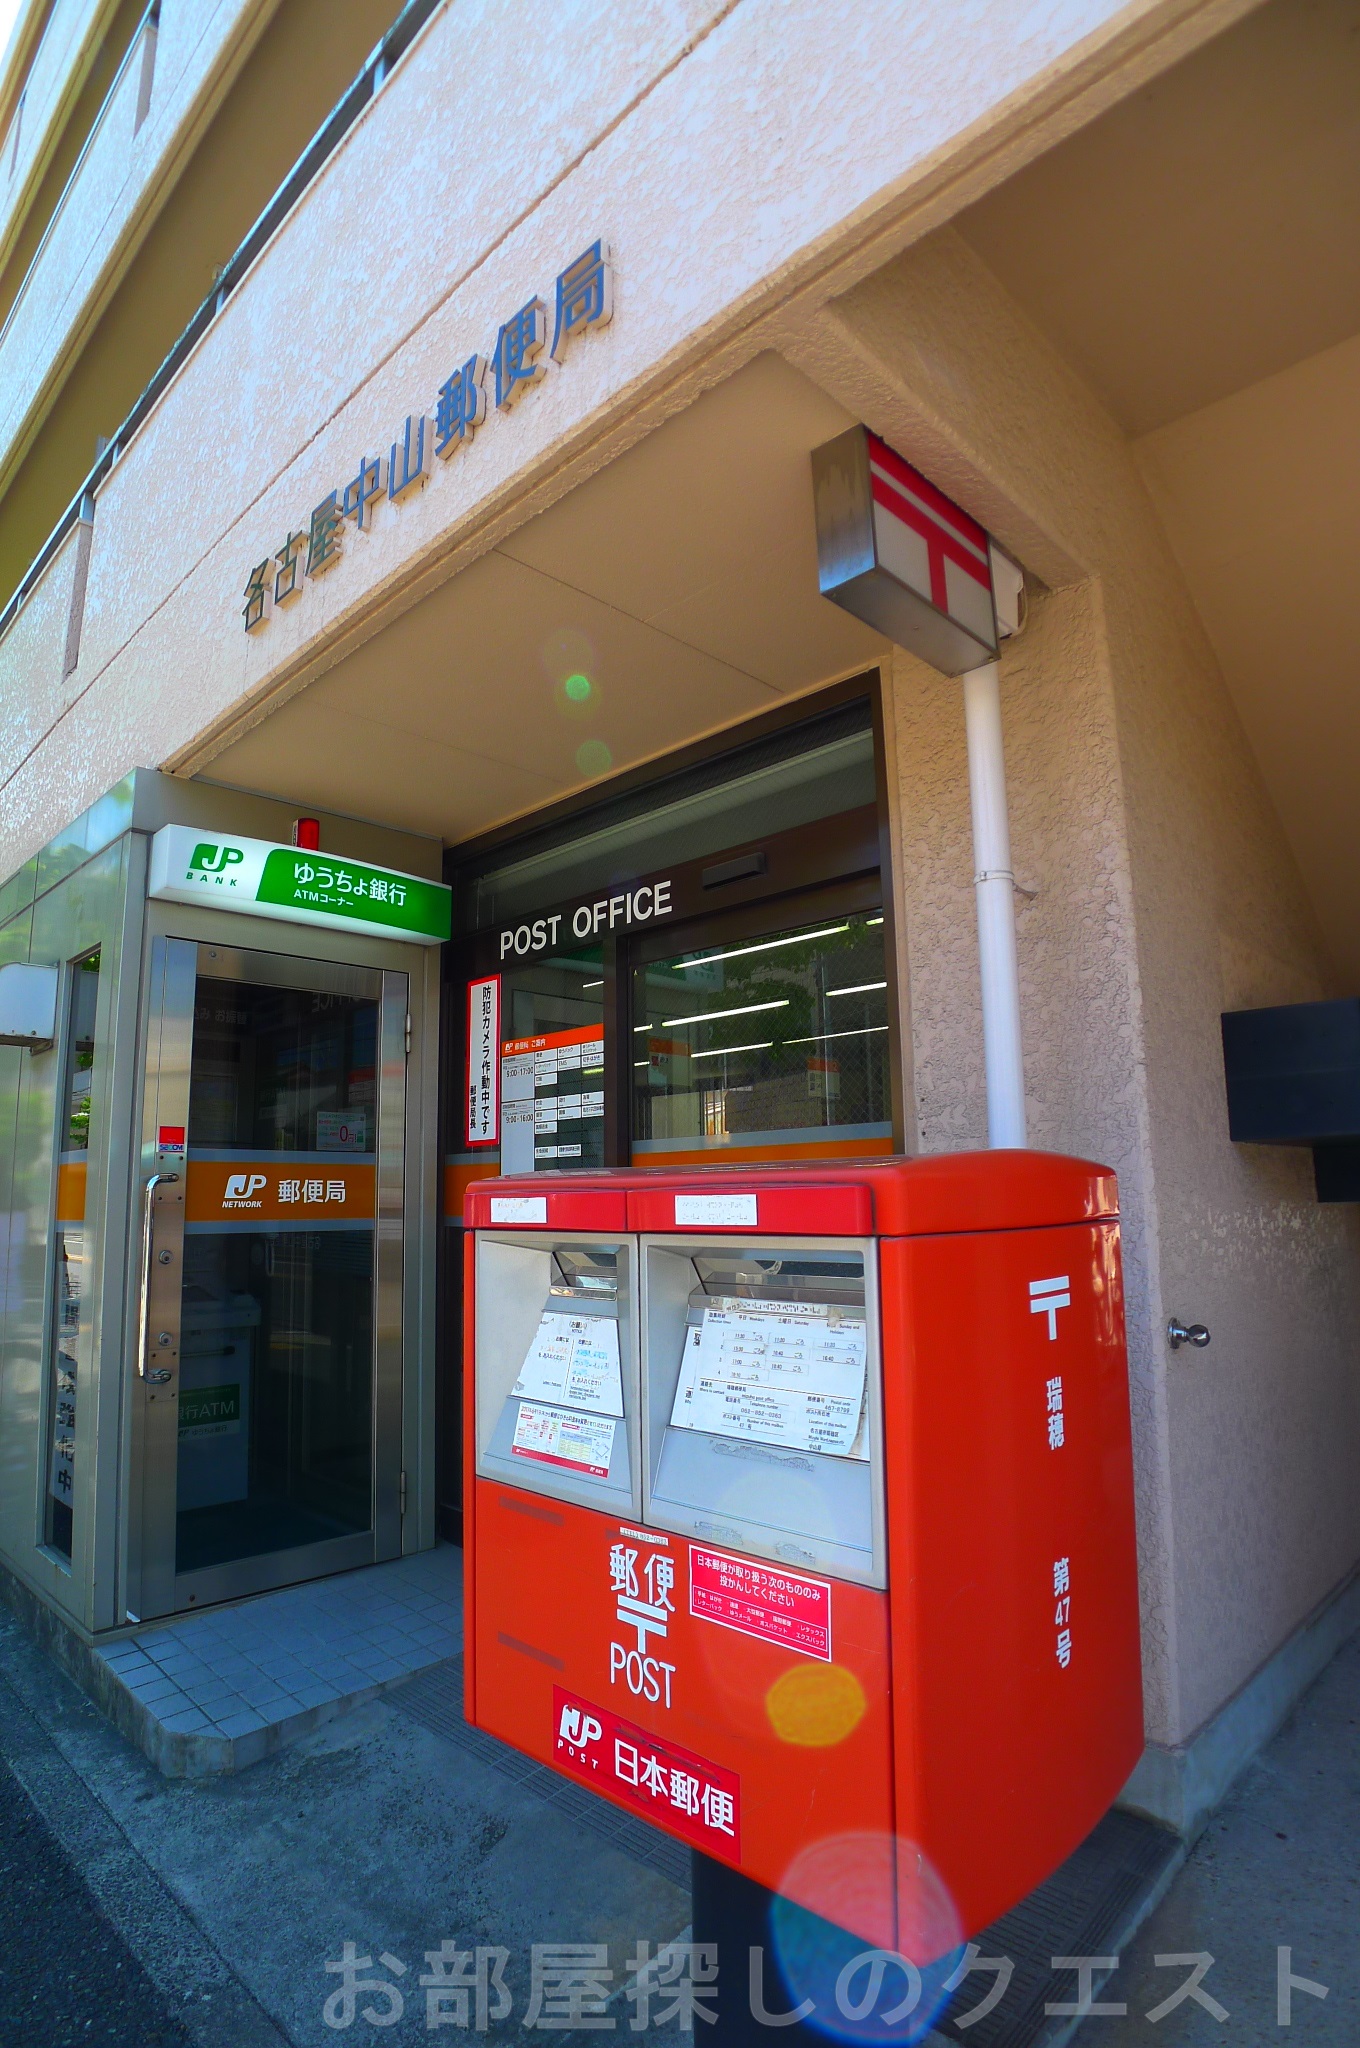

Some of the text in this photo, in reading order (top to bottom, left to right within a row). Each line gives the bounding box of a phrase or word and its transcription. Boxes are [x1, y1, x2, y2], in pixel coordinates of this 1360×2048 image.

[242, 237, 613, 634] 名古屋中山郵便局
[186, 871, 237, 887] BANK
[294, 862, 406, 907] ゆうちょ銀行
[294, 888, 354, 906] ATMコーナー
[500, 880, 672, 960] POST OFFICE
[481, 986, 492, 1135] 防犯カメラ作動中です
[222, 1200, 262, 1208] NETWORK
[278, 1179, 346, 1204] 郵便局
[1046, 1375, 1065, 1451] 瑞穂
[610, 1543, 676, 1612] 郵便
[697, 1554, 821, 1601] 日本郵便が取り扱う次のもののみ
[719, 1575, 795, 1607] 投かんしてください
[610, 1640, 677, 1709] POST
[557, 1740, 599, 1771] POST
[614, 1738, 735, 1837] 日本郵便
